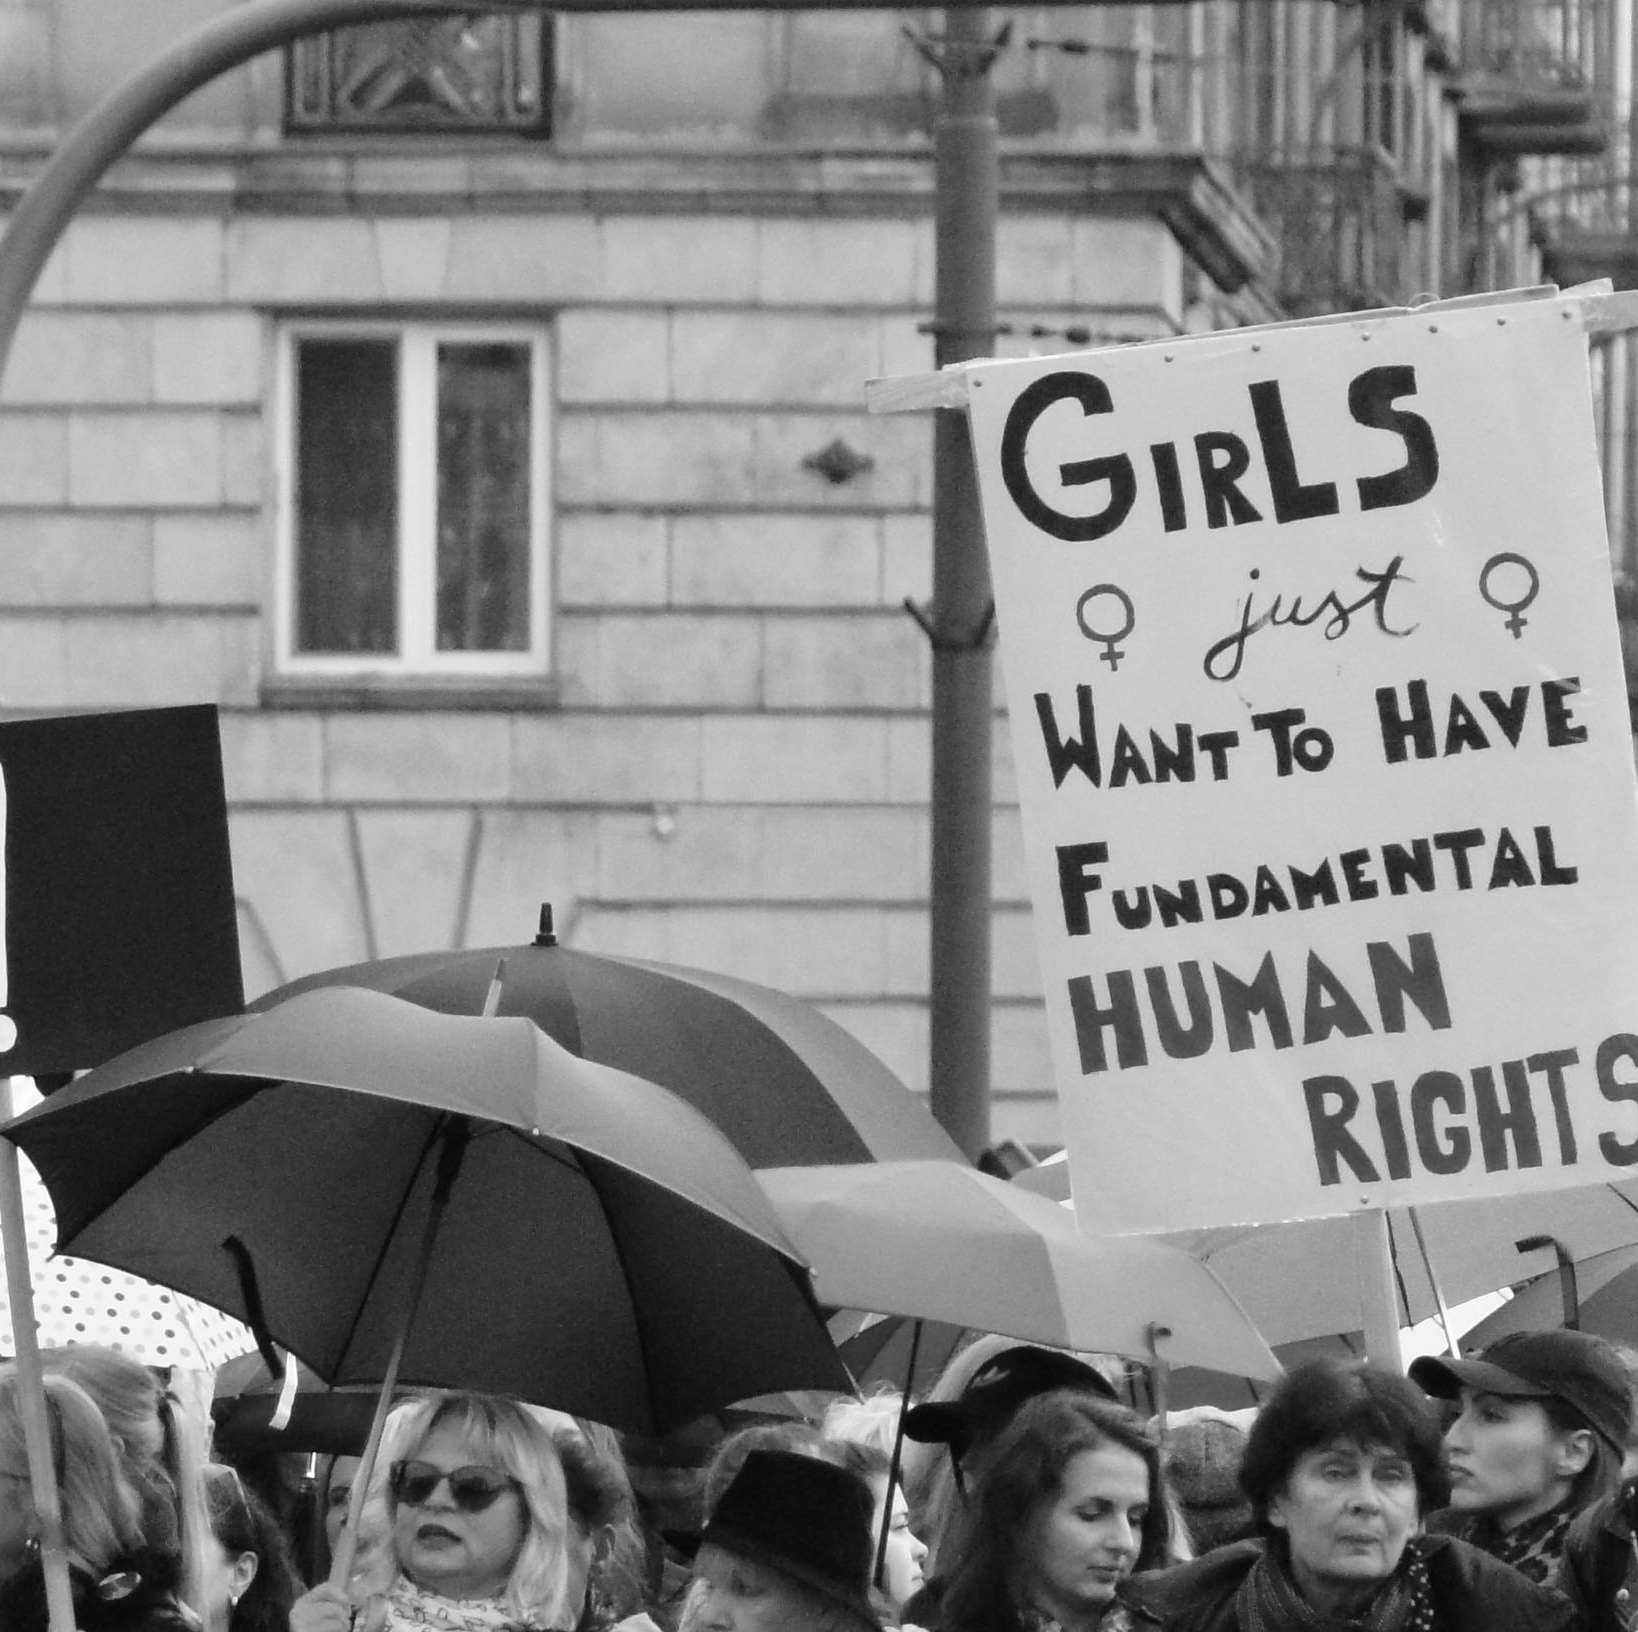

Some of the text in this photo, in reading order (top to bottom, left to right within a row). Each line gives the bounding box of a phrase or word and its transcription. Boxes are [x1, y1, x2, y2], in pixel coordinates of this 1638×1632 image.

[1000, 364, 1440, 542] GIRLS
[1202, 554, 1421, 681] just
[1034, 684, 1240, 790] WANT
[1375, 676, 1589, 764] HAVE
[1055, 825, 1579, 937] FUNDAMENTAL
[1067, 931, 1452, 1075] HUMAN
